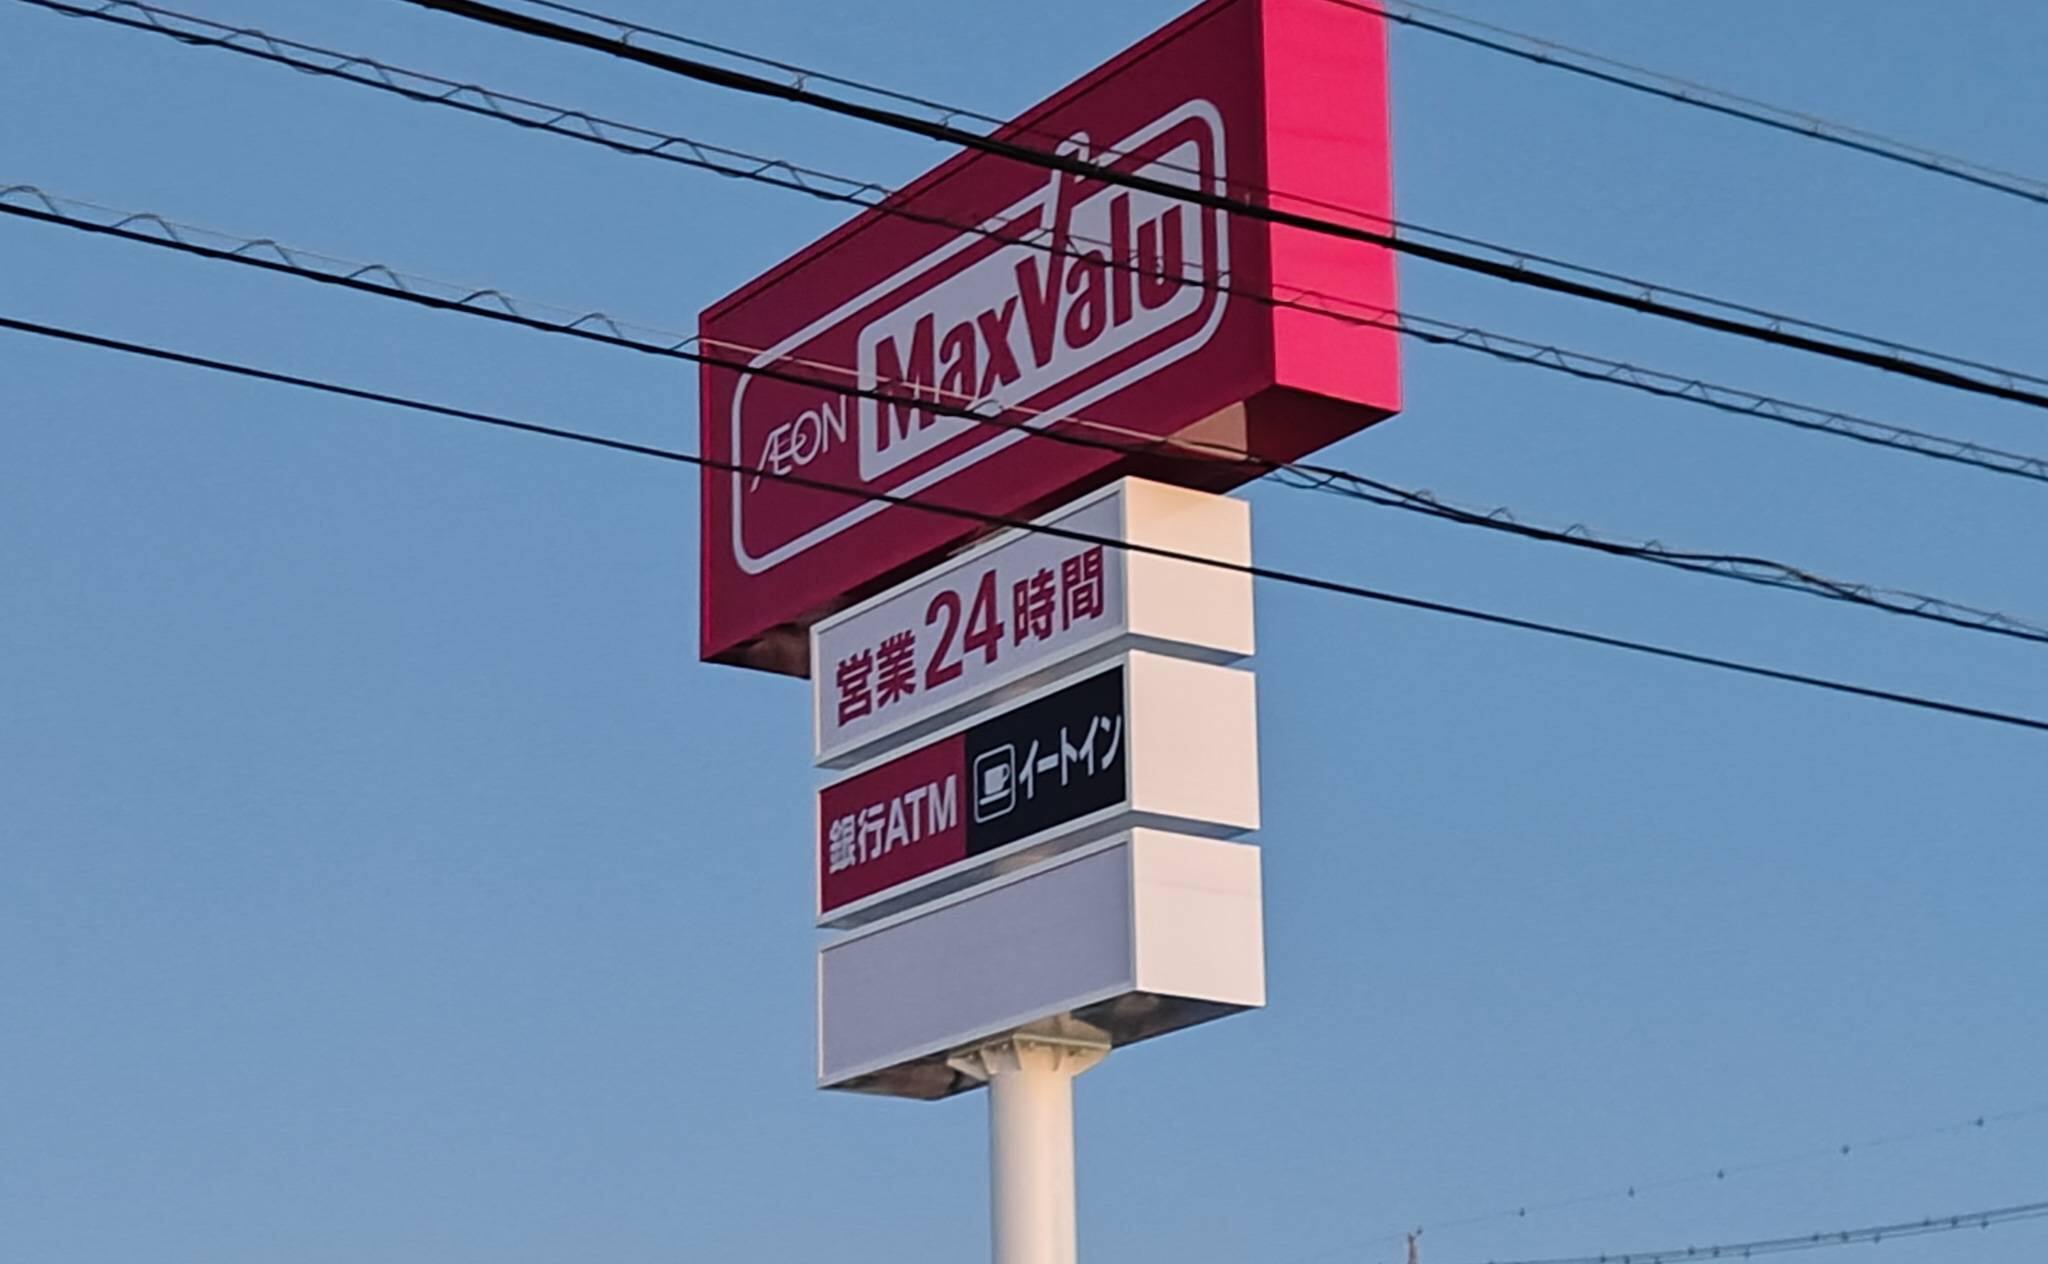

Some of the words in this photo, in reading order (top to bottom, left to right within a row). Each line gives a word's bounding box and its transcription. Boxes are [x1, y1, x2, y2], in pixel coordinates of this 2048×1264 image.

[875, 142, 1182, 455] MaxValu
[1018, 715, 1123, 799] イートイン
